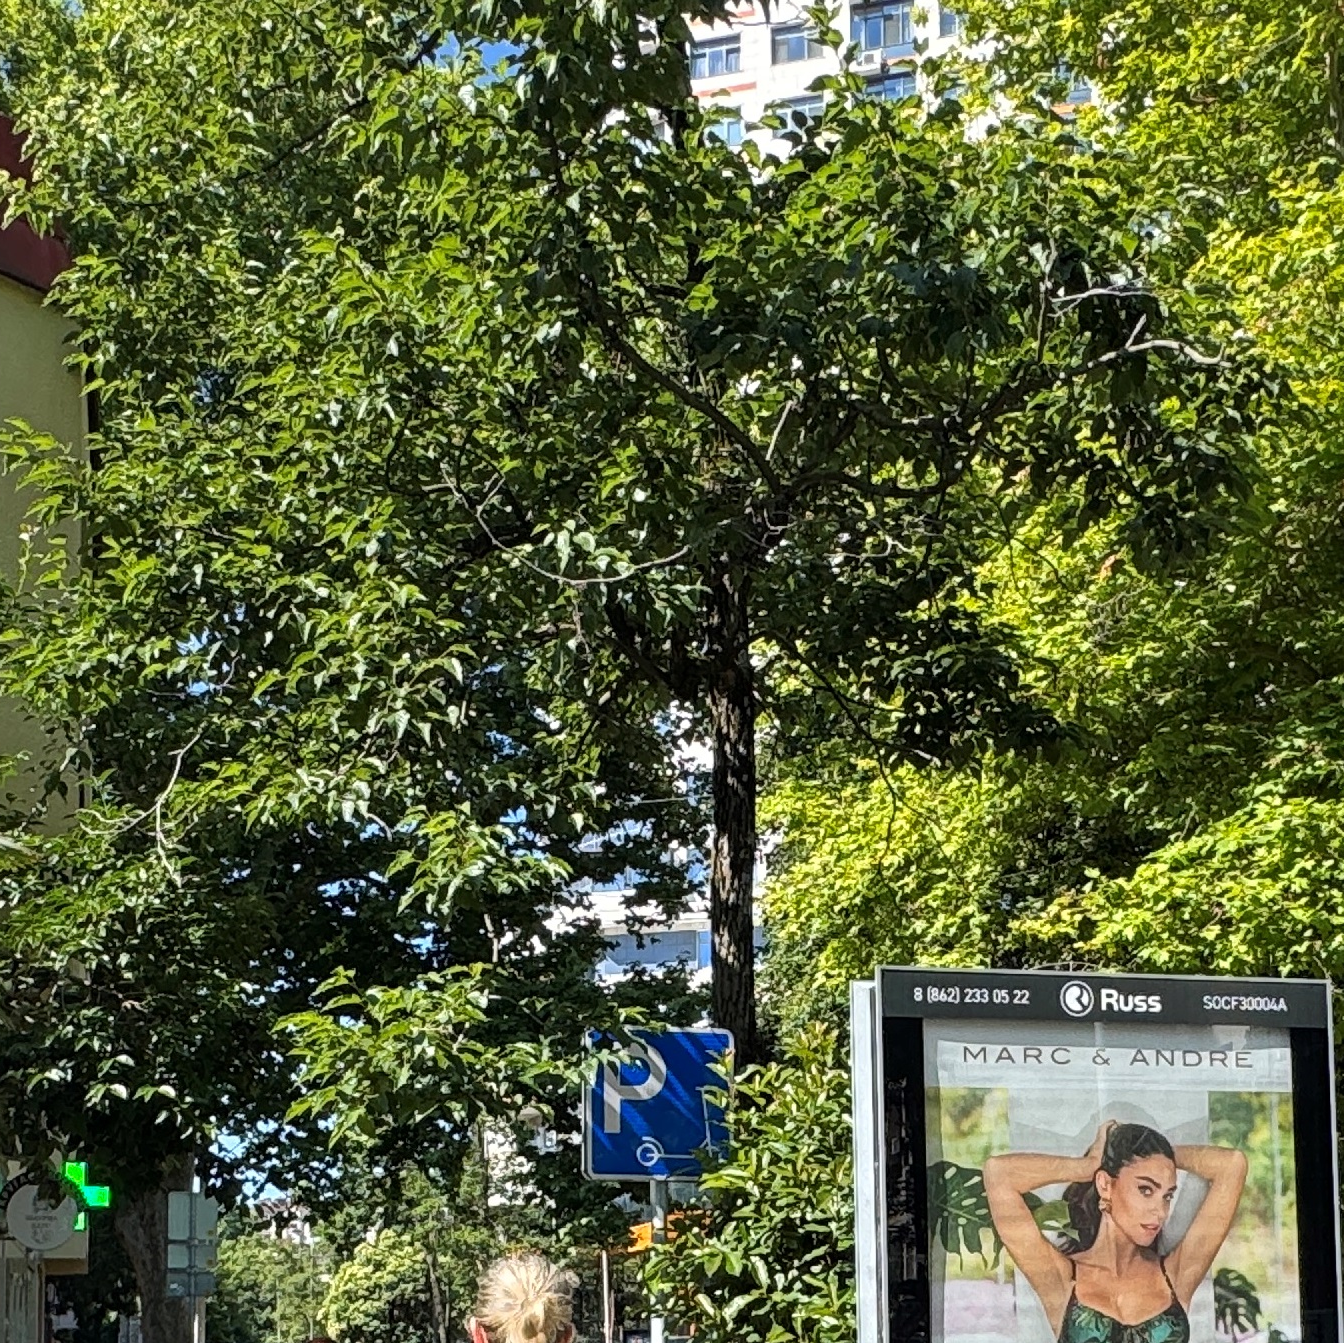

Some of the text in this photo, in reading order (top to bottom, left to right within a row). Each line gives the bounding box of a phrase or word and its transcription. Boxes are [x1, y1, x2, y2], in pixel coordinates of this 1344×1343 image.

[913, 985, 1030, 1004] 8 (862) 233 05 22
[1100, 988, 1163, 1013] Russ
[963, 1045, 1254, 1069] MARC & ANDRE
[603, 1040, 667, 1134] P
